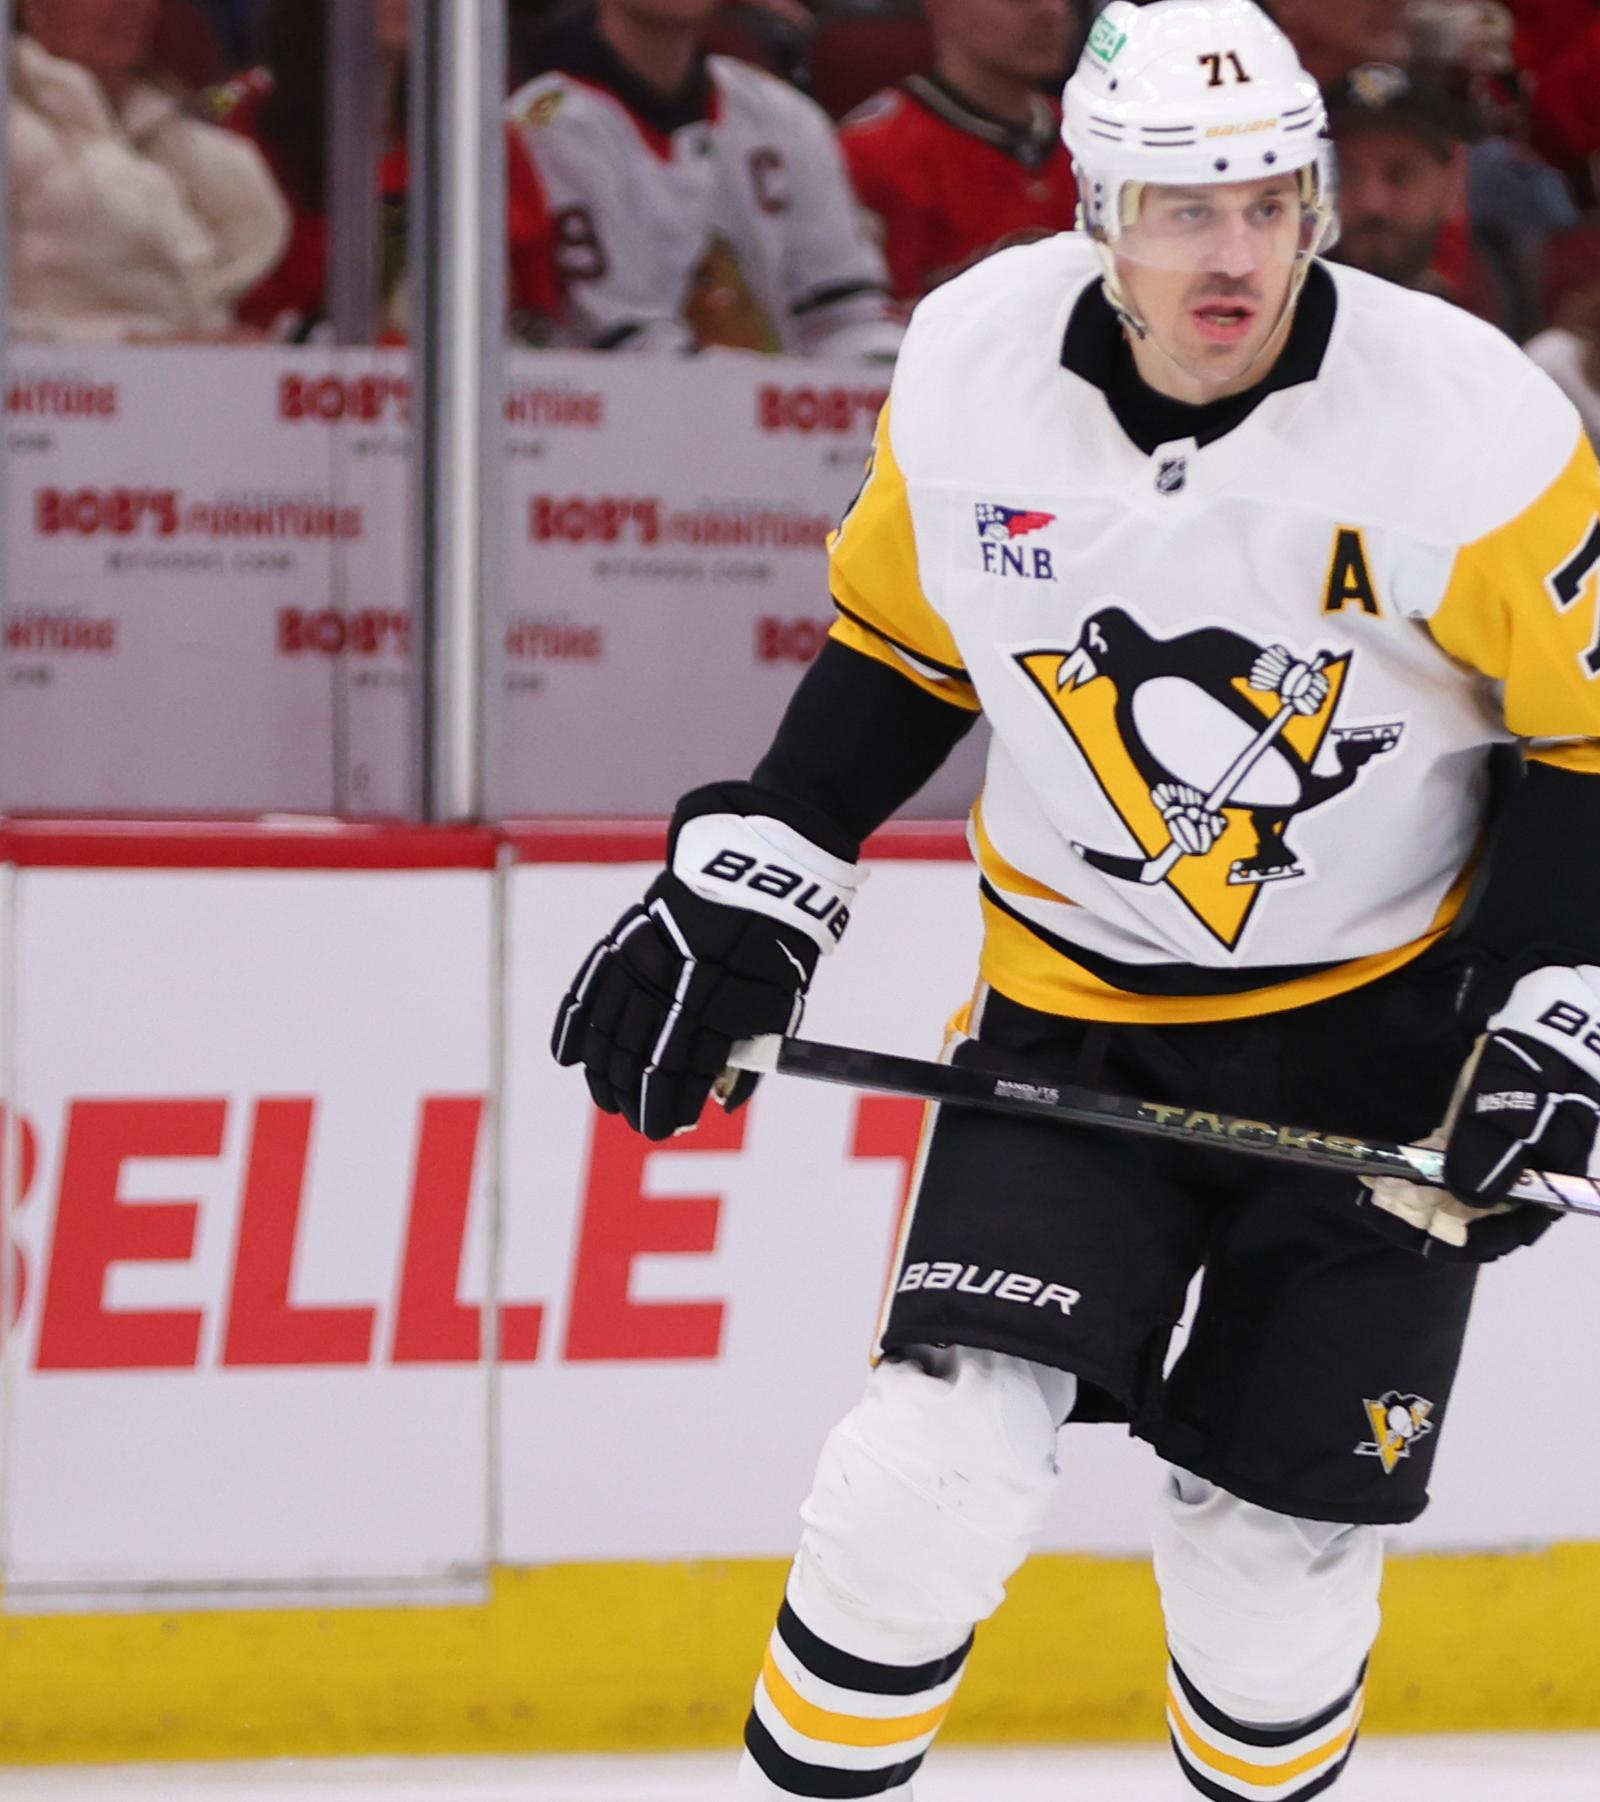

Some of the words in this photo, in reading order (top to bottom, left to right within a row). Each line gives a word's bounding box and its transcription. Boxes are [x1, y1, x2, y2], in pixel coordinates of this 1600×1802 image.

[1198, 50, 1251, 87] 71
[750, 146, 788, 214] C
[35, 487, 181, 538] BOB'S
[528, 495, 661, 546] BOB'S
[979, 541, 1058, 583] F.N.B.
[1322, 522, 1383, 618] A
[1141, 1101, 1367, 1159] TACKS
[0, 1095, 750, 1372] ELLE
[897, 1261, 1082, 1315] BAUER
